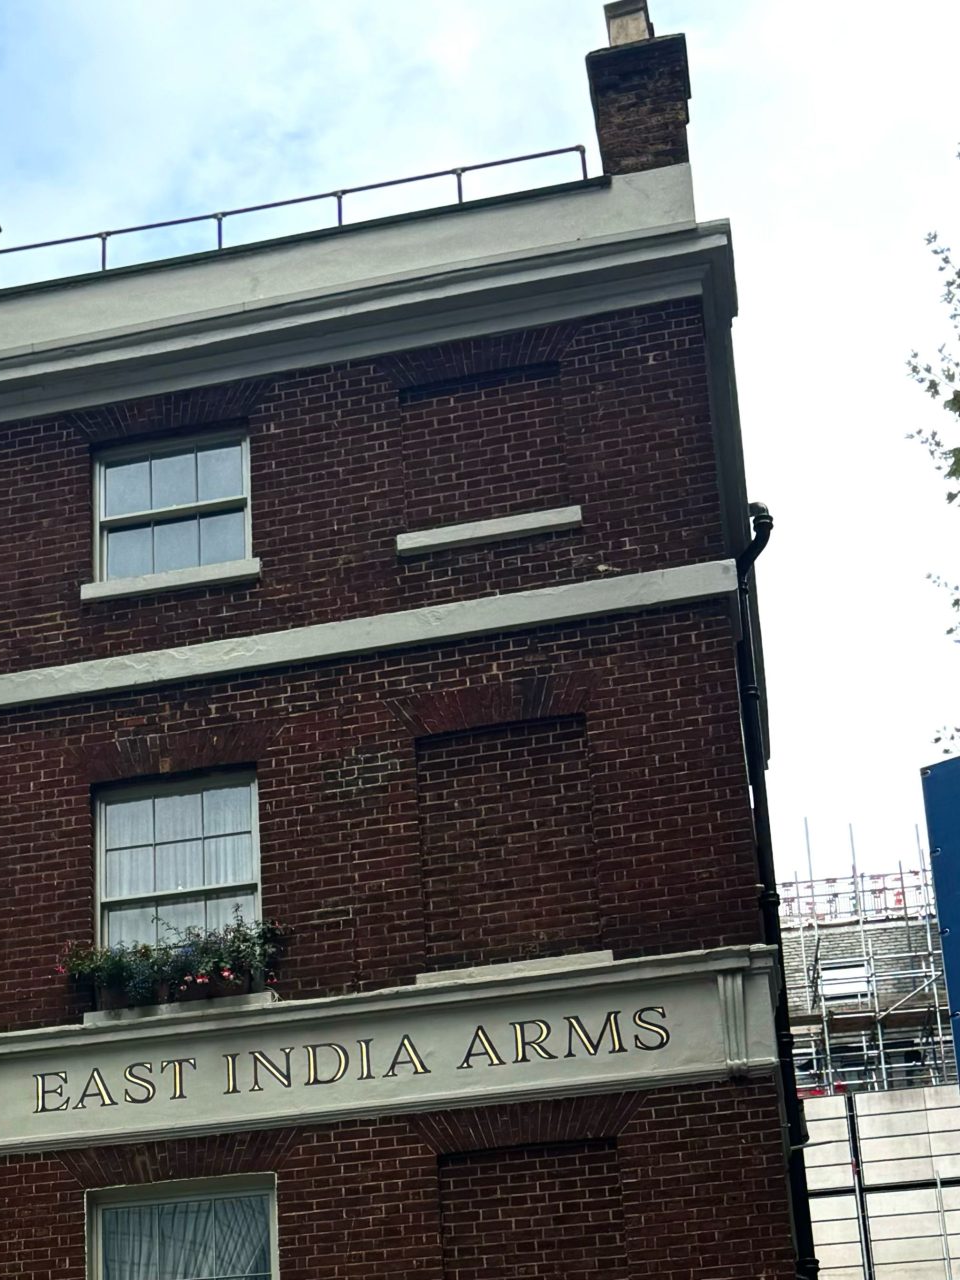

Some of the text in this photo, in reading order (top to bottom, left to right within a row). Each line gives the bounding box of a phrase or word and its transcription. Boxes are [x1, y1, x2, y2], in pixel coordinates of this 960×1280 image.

[33, 1006, 672, 1114] EAST INDIA ARMS
